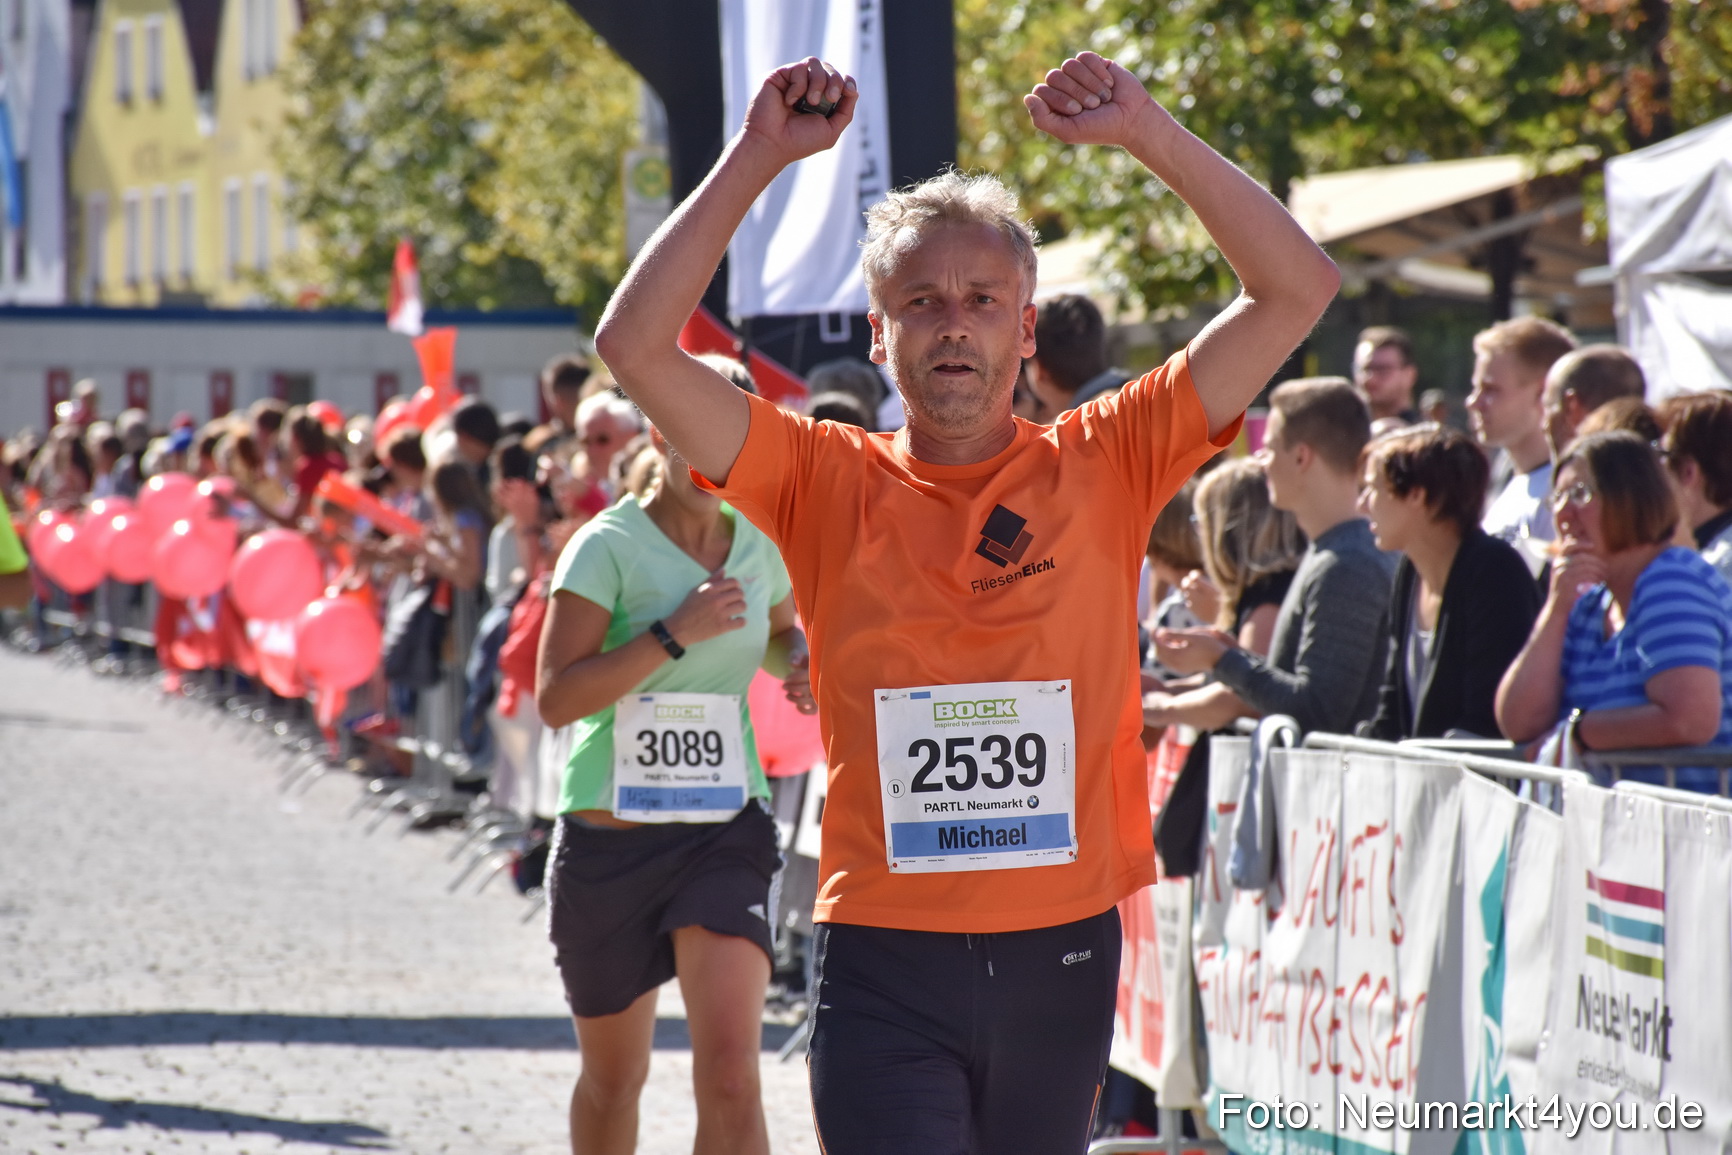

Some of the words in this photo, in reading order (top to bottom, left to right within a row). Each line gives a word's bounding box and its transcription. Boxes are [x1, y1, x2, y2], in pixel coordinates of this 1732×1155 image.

[655, 705, 705, 718] BOCK
[933, 698, 1019, 721] BOCK
[934, 721, 960, 729] inspired
[992, 718, 1020, 726] concepts
[636, 730, 723, 768] 3089
[908, 732, 1047, 793] 2539
[892, 784, 900, 794] D
[924, 801, 964, 813] PARTL
[967, 798, 1023, 811] Neumarkt
[938, 822, 1027, 850] Michael
